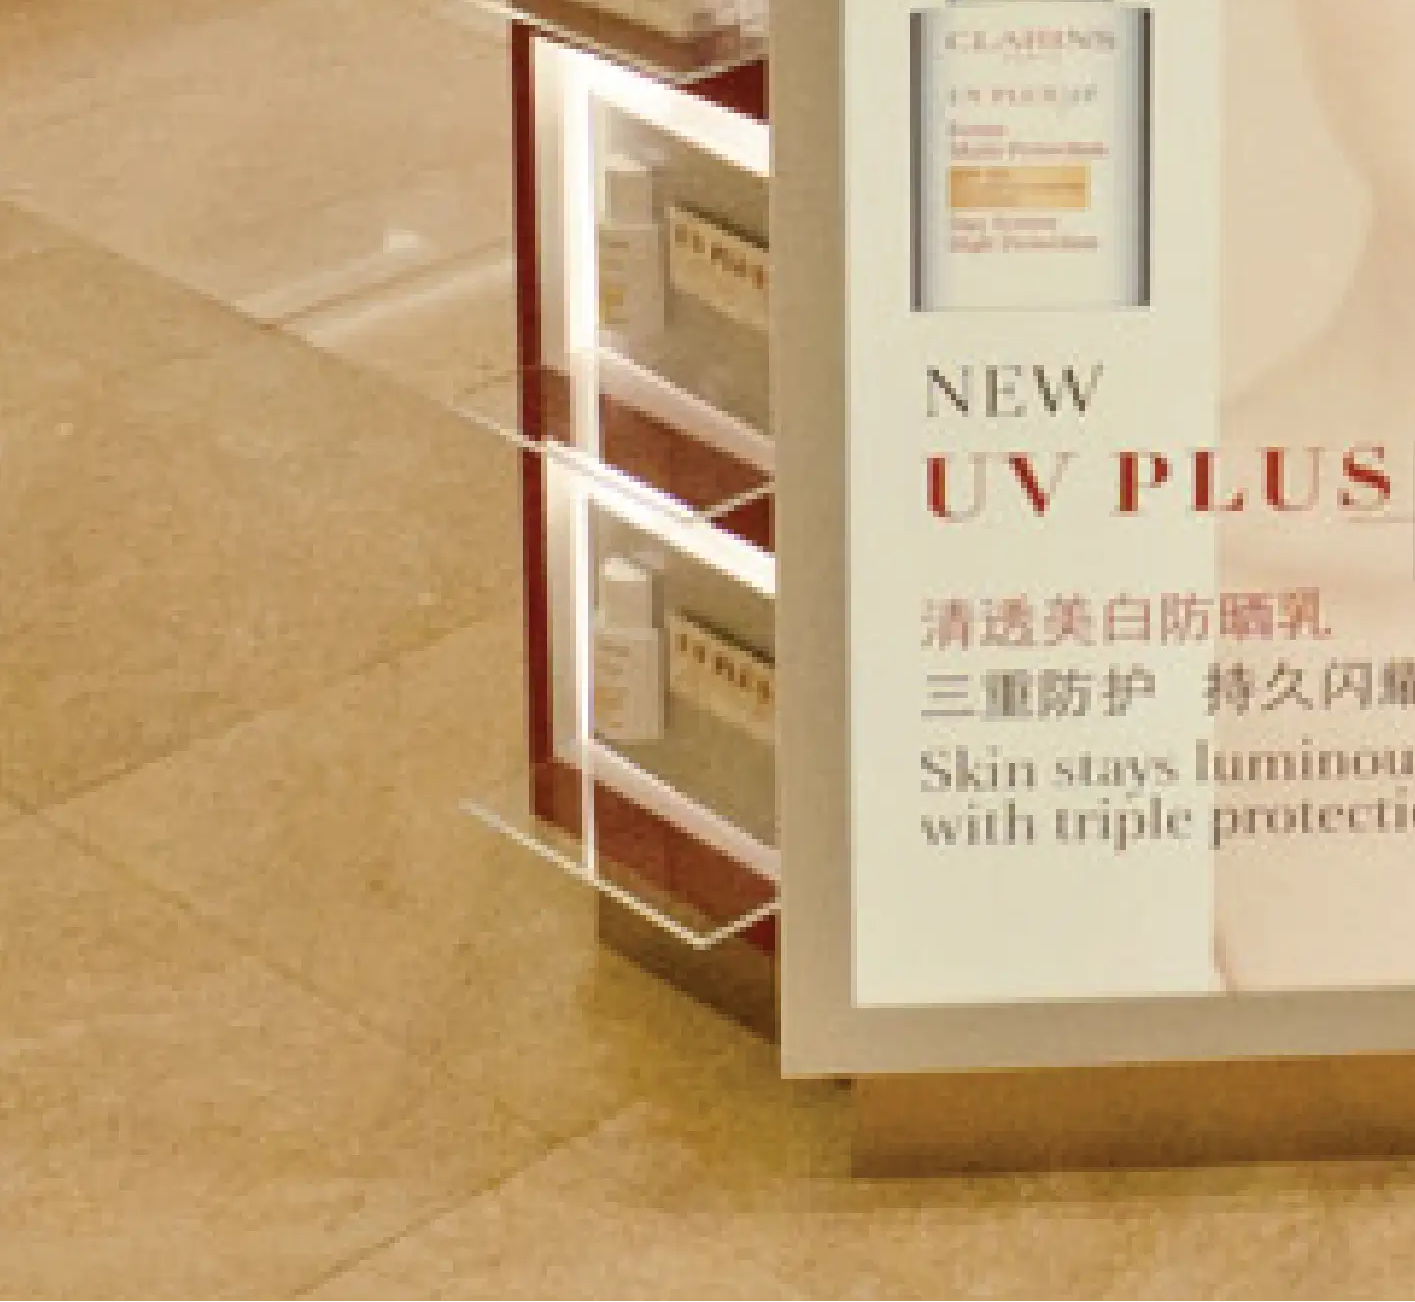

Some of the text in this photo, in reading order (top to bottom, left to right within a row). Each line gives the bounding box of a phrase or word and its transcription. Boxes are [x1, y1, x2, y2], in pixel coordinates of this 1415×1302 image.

[924, 361, 1105, 419] NEW
[924, 448, 1079, 522] UV
[1110, 443, 1394, 515] PLUS
[919, 587, 1333, 652] 清透美白防晒乳
[920, 664, 1157, 723] 三重防护
[920, 744, 1036, 793] Skin
[1053, 750, 1181, 800] stays
[920, 800, 1036, 848] with
[1054, 797, 1193, 852] triple
